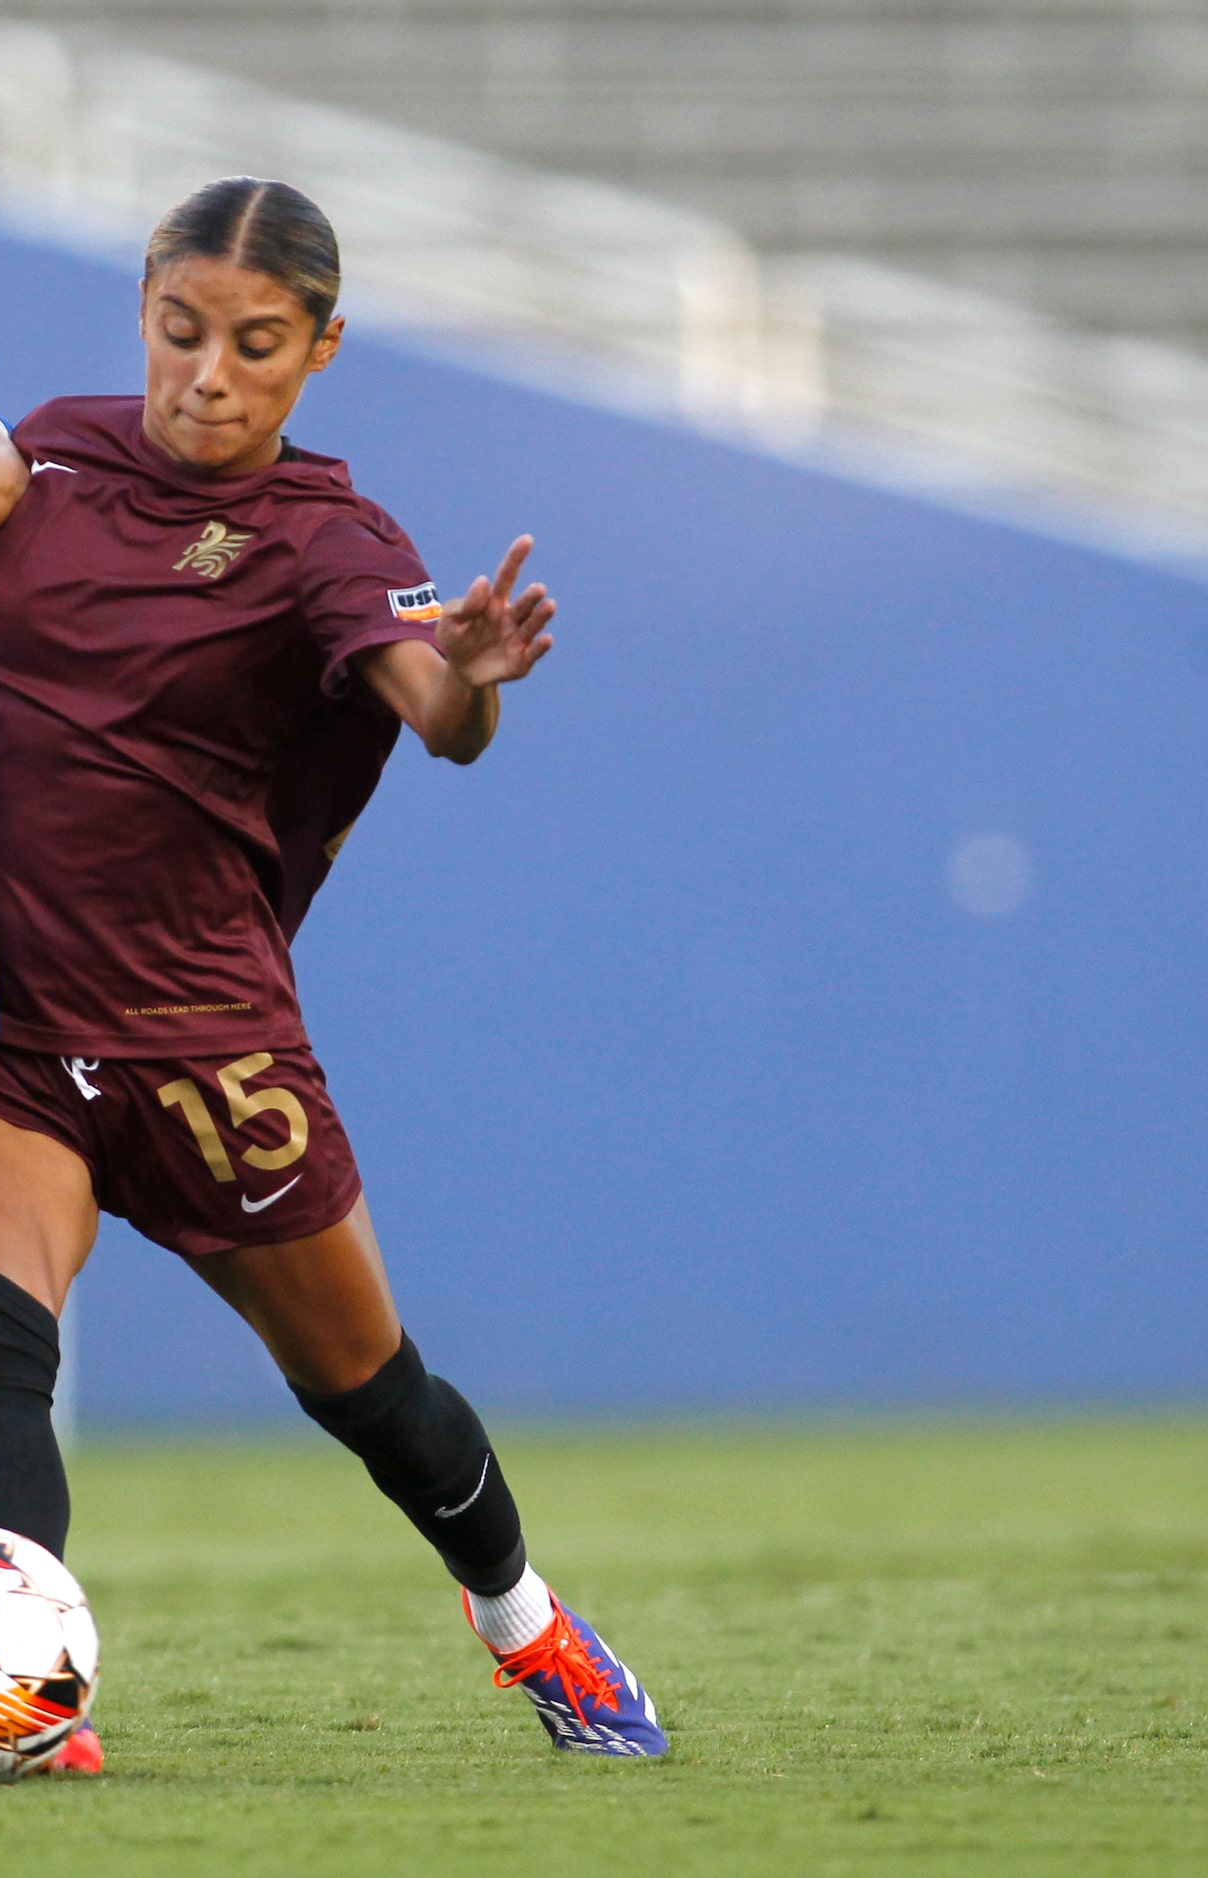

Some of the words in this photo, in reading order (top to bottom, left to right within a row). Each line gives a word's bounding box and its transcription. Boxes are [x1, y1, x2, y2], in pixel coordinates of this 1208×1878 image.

[125, 1007, 139, 1016] ALL
[141, 1006, 168, 1015] ROADS
[169, 1005, 189, 1014] LEAD
[190, 1004, 229, 1012] THROUGH
[230, 1002, 251, 1010] HERE
[157, 1051, 309, 1183] 15
